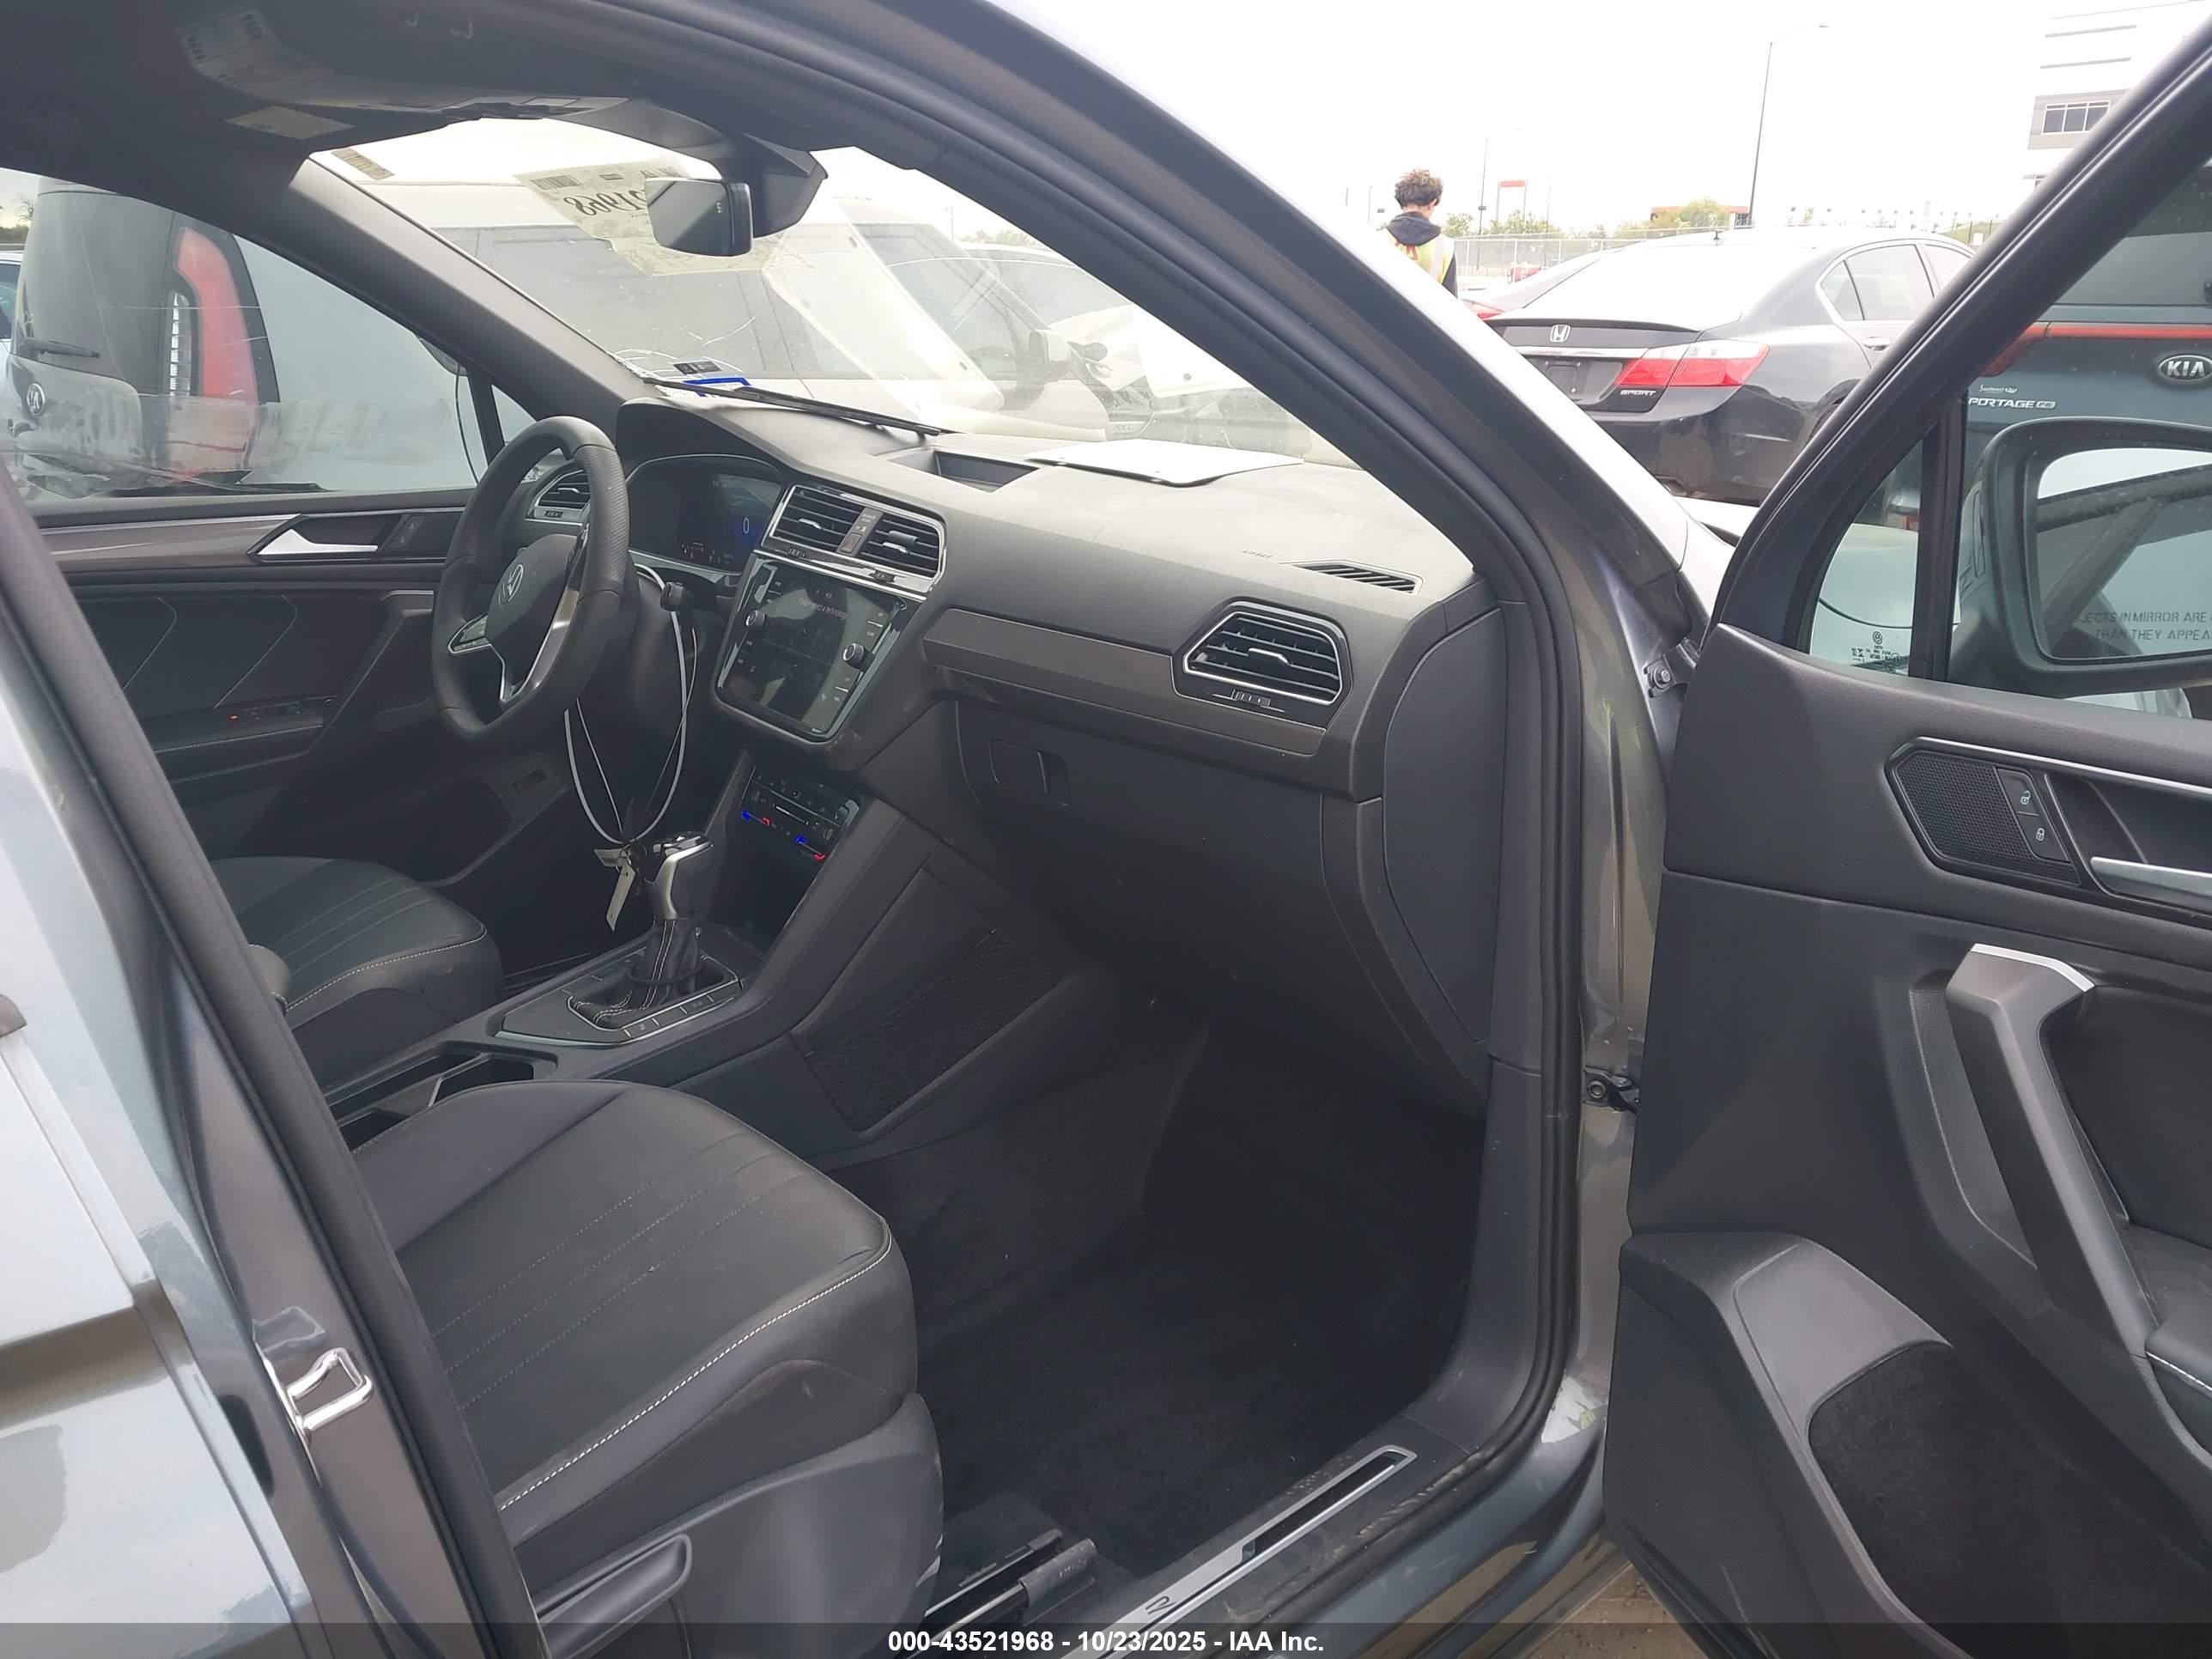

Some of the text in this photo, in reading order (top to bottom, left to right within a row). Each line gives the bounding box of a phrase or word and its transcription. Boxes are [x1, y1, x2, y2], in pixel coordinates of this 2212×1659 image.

[2166, 360, 2206, 377] KIA
[1968, 397, 2035, 410] PORTAGE
[2119, 611, 2131, 623] IN
[2133, 611, 2180, 623] MIRROR
[2184, 611, 2208, 623] ARE
[2132, 629, 2163, 641] THEY
[2167, 629, 2212, 641] APPEA
